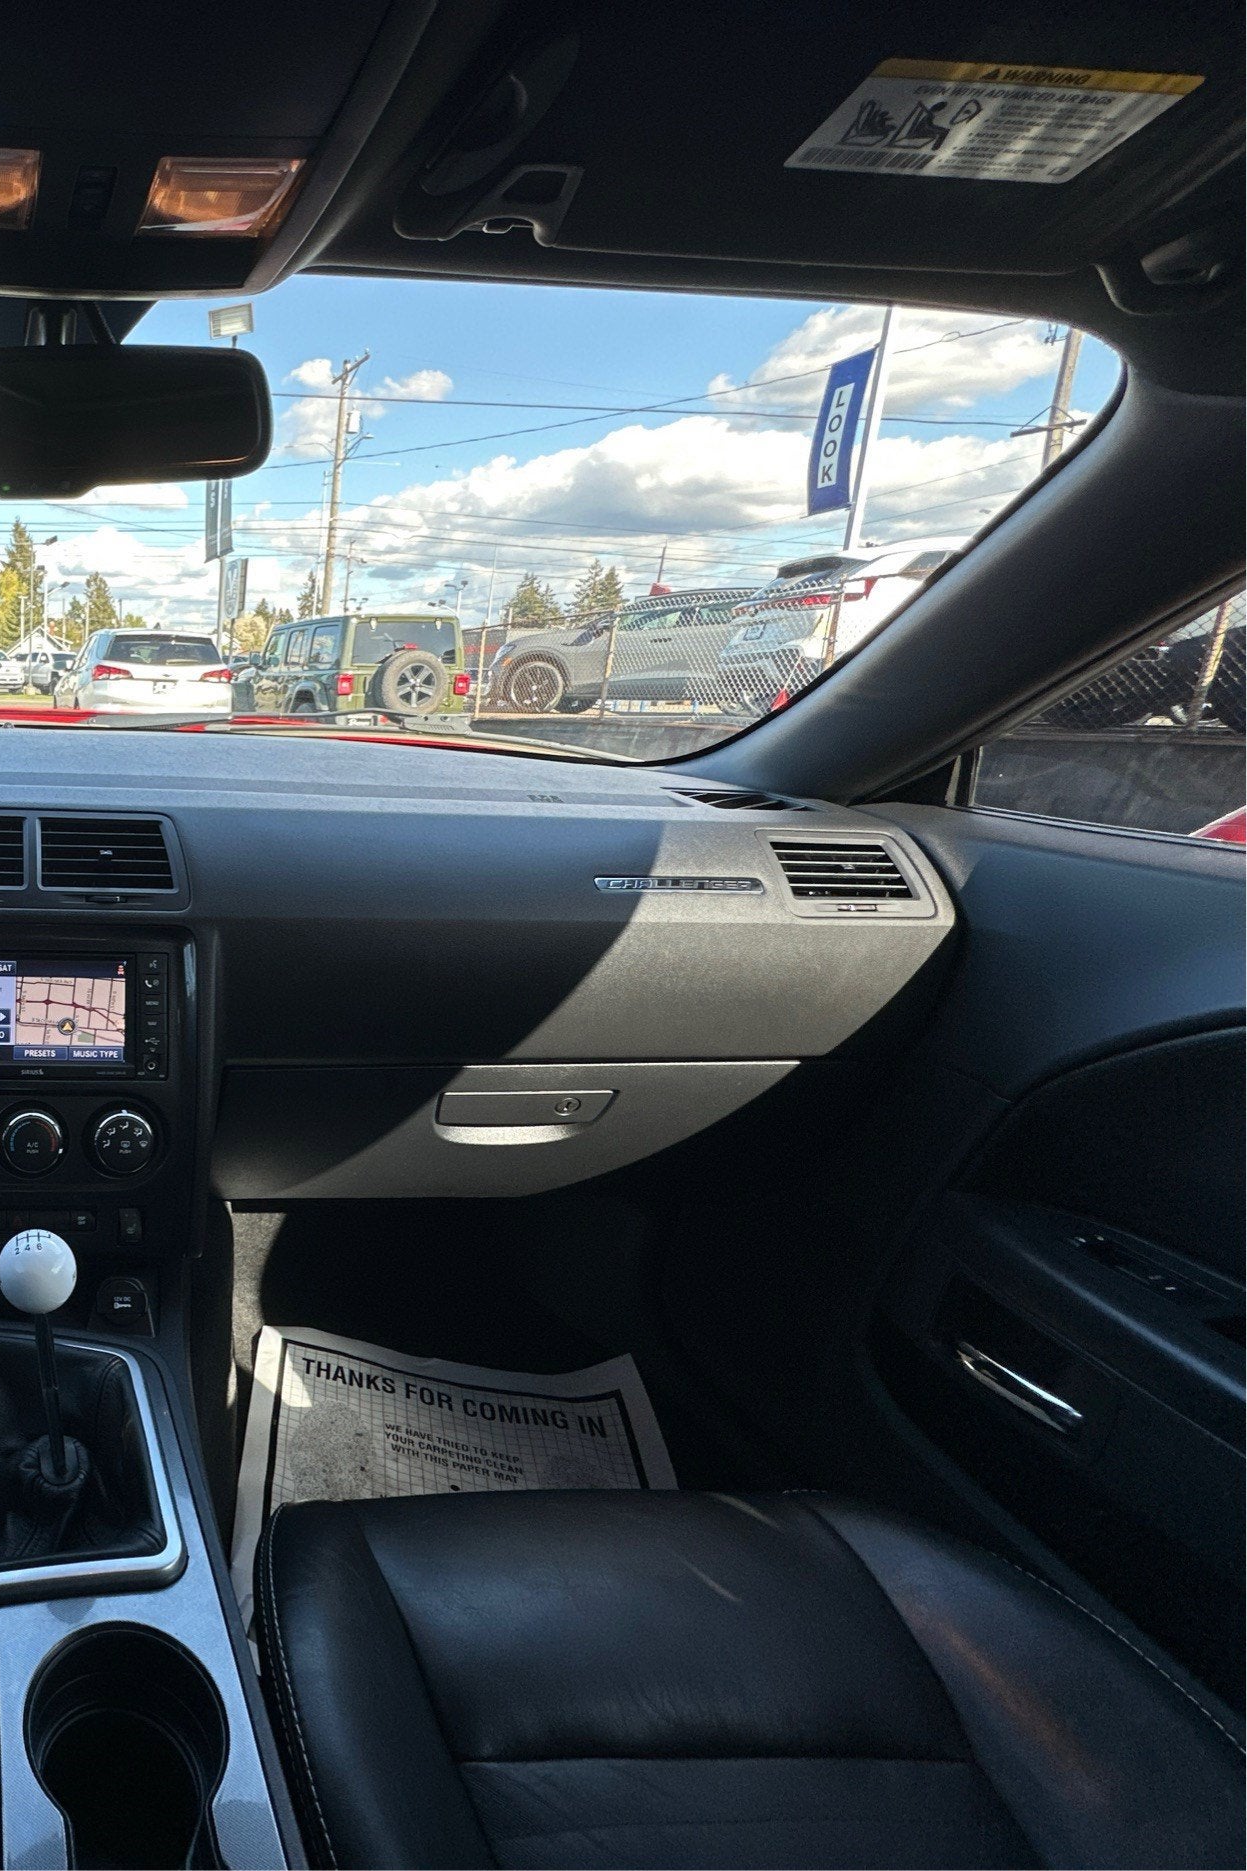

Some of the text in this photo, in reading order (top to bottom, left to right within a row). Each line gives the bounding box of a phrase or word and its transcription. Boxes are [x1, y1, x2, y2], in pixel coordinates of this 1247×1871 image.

[1002, 70, 1092, 85] WARNING
[949, 86, 984, 98] WITH
[984, 89, 1055, 101] ADVANCED
[1057, 94, 1079, 102] AIR
[1077, 95, 1117, 105] BAGS
[820, 389, 845, 484] LOOK
[607, 880, 752, 890] CHALLENGER
[24, 1049, 56, 1057] PRESETS
[73, 1050, 119, 1058] MUSIC TYPE
[15, 1247, 21, 1255] 2
[24, 1243, 31, 1252] 4
[36, 1243, 43, 1251] 6
[302, 1357, 608, 1439] THANKS FOR COMING IN
[385, 1423, 520, 1463] WE HAVE TRIED TO KEEP
[384, 1431, 524, 1475] YOUR CARPETING CLEAN
[390, 1443, 519, 1484] WITH THIS PAPER MAT
